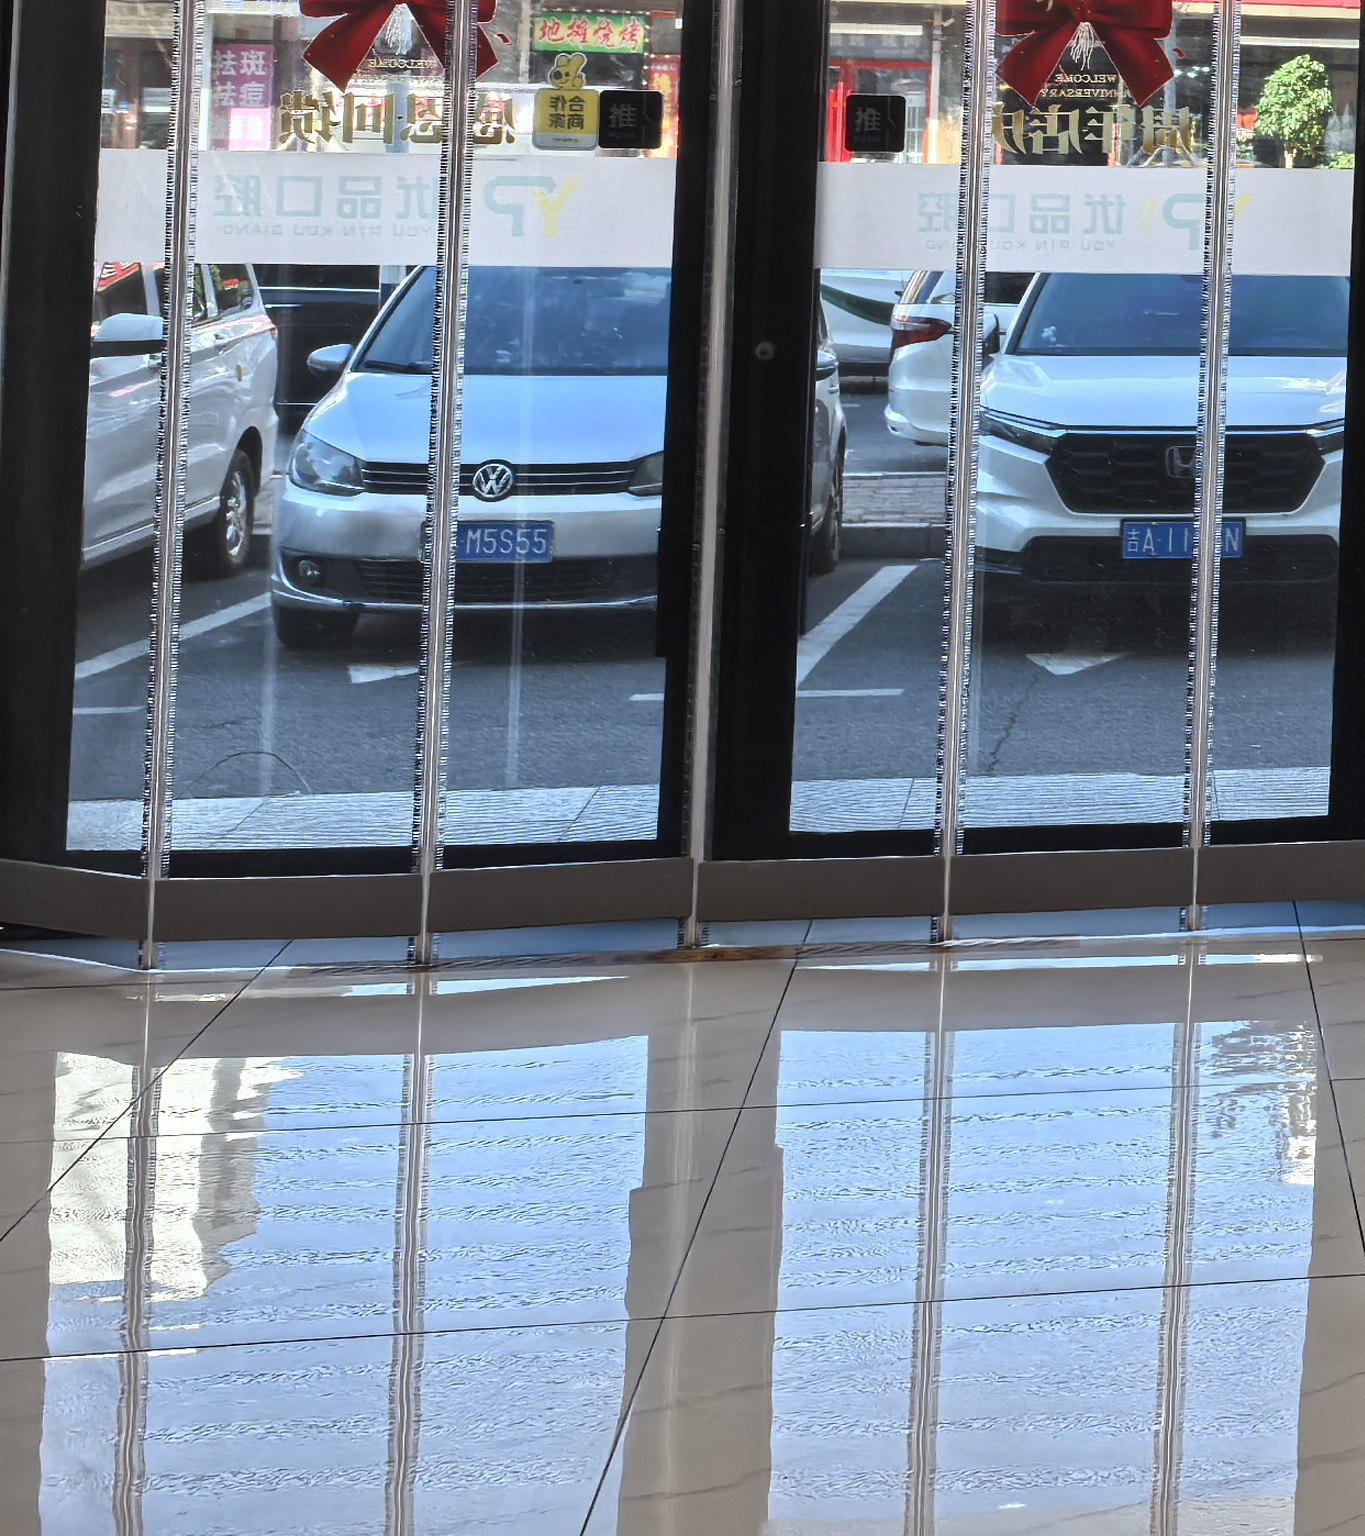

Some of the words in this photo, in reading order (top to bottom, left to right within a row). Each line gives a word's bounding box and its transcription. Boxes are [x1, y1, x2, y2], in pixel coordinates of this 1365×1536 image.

[539, 18, 643, 50] 地摊烧烤
[214, 50, 266, 76] 祛斑
[214, 81, 265, 107] 祛痘
[855, 106, 881, 131] 推
